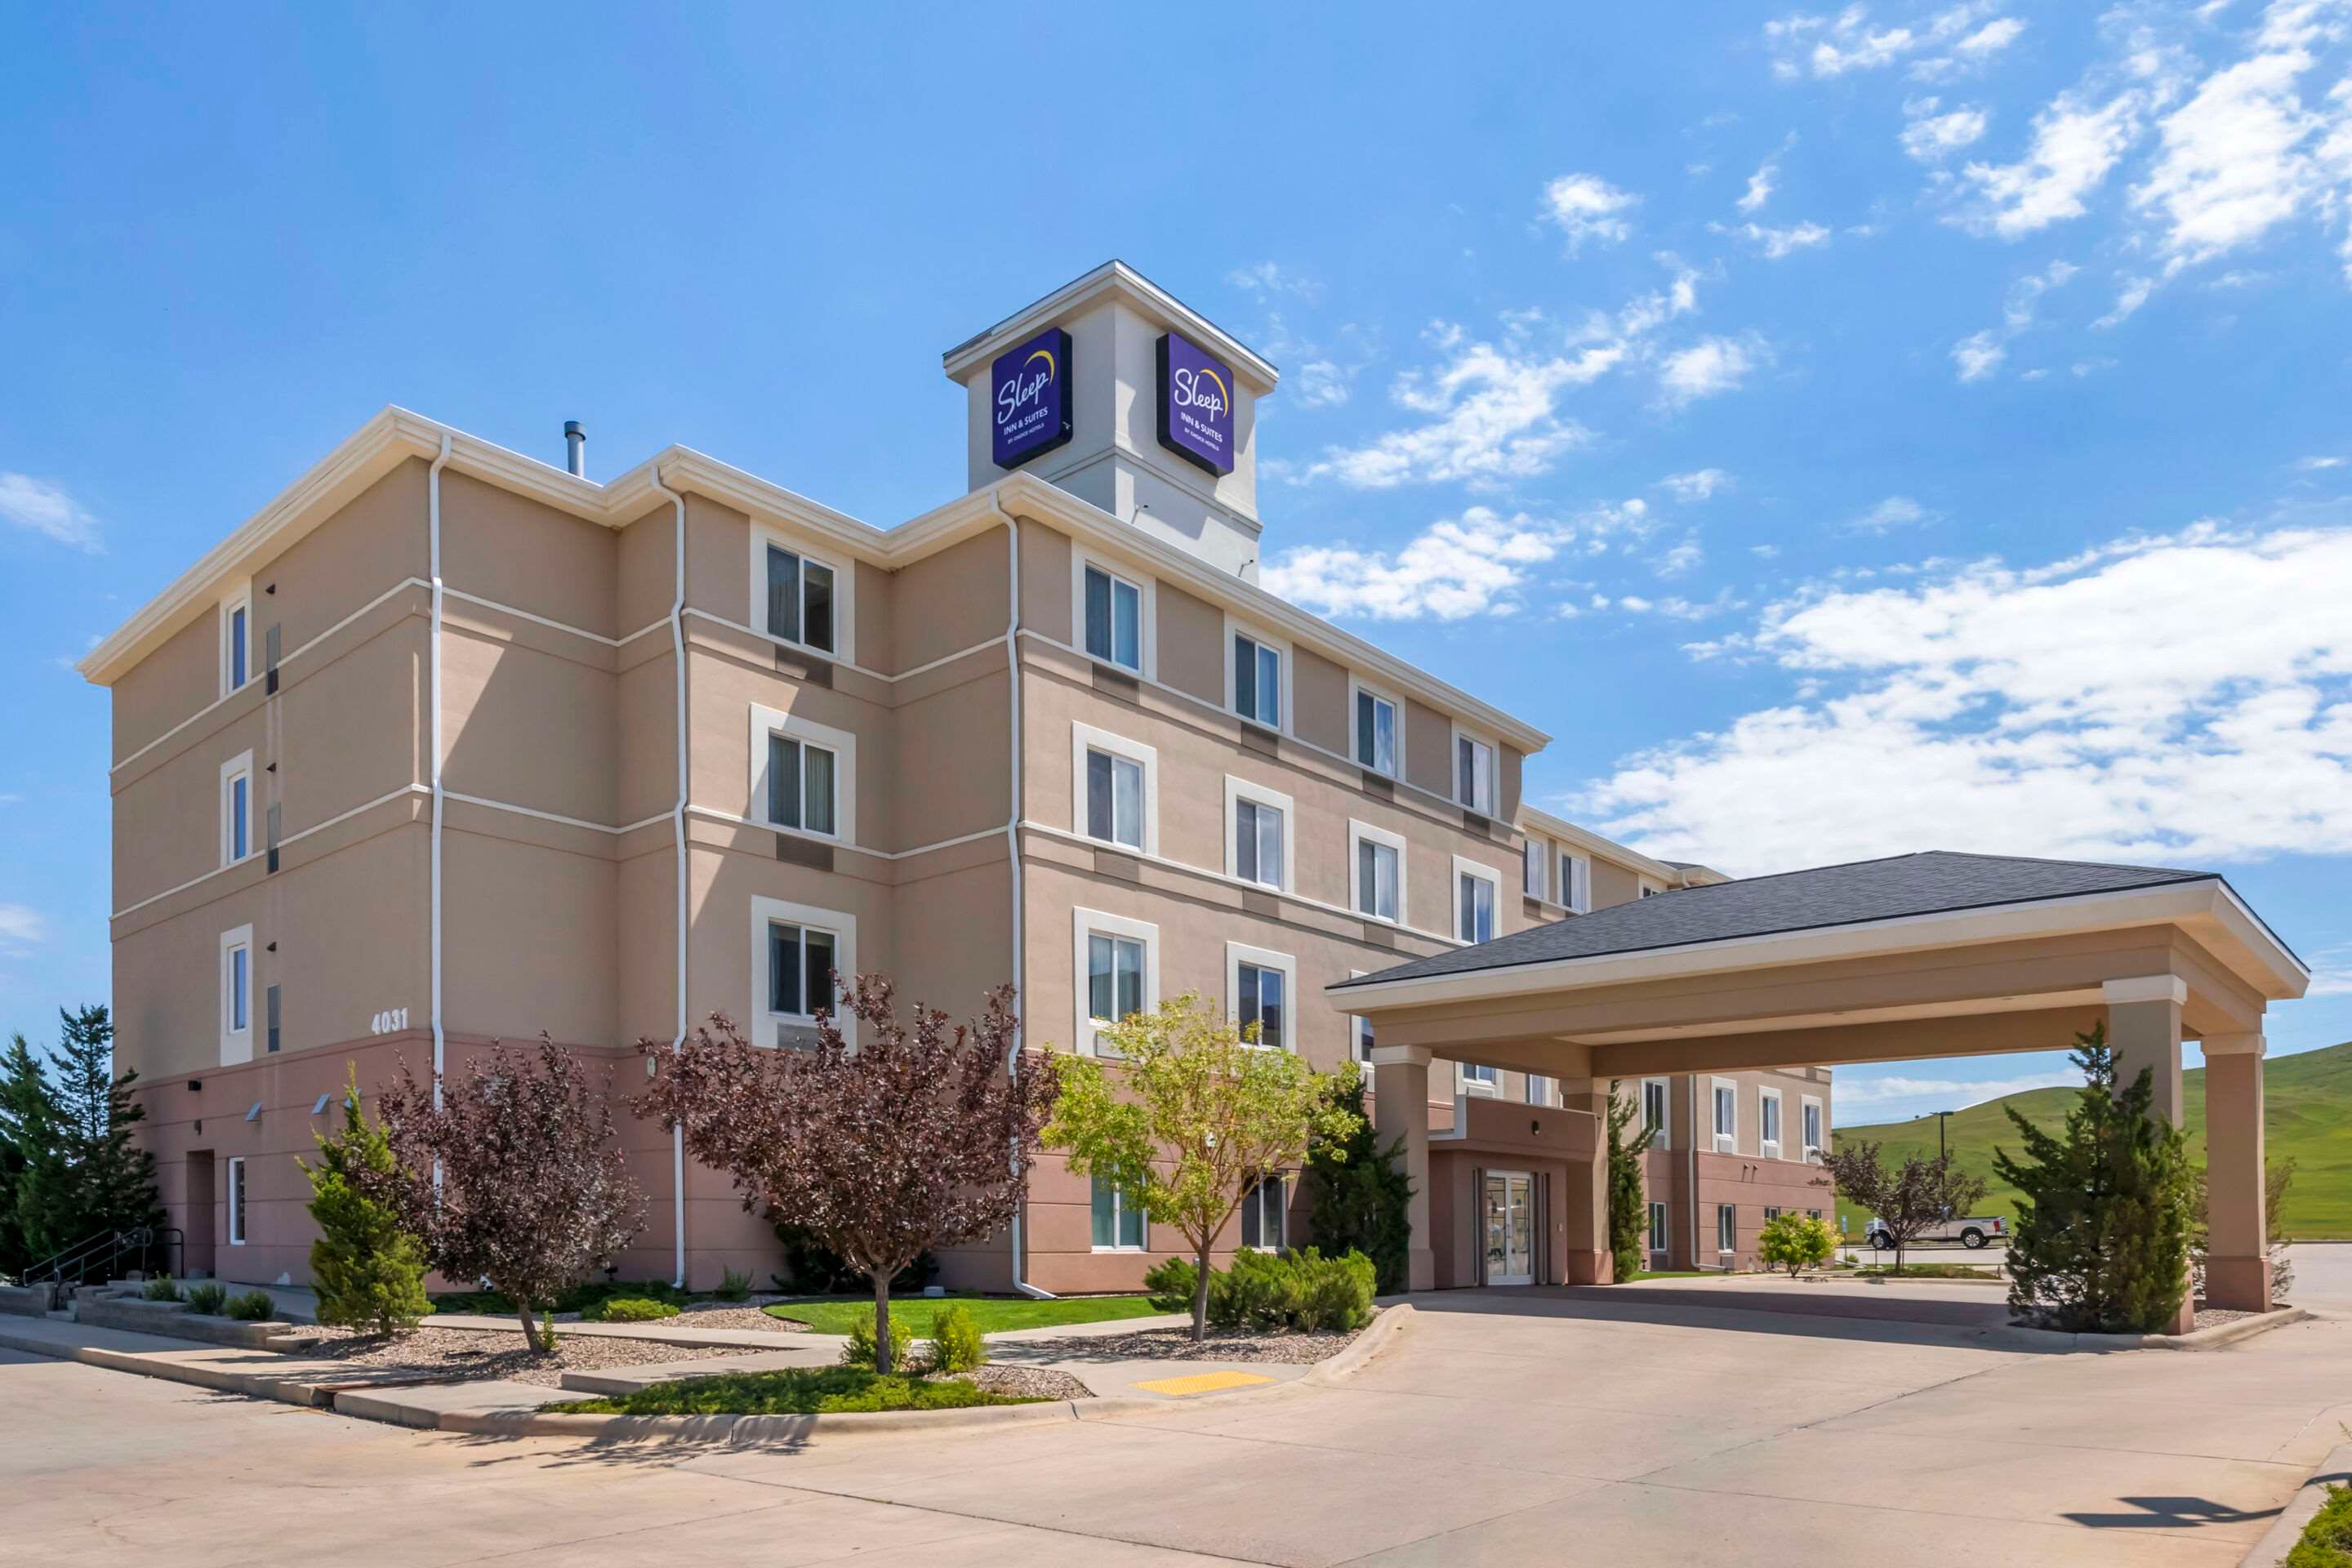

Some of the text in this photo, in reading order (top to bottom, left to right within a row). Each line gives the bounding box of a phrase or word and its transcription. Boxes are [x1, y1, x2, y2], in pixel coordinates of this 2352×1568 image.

[998, 372, 1049, 424] Sleep
[1174, 368, 1223, 422] Sleep
[1004, 407, 1049, 435] INN & SUITES
[1180, 411, 1223, 443] INN & SUITES
[372, 1007, 408, 1035] 4031
